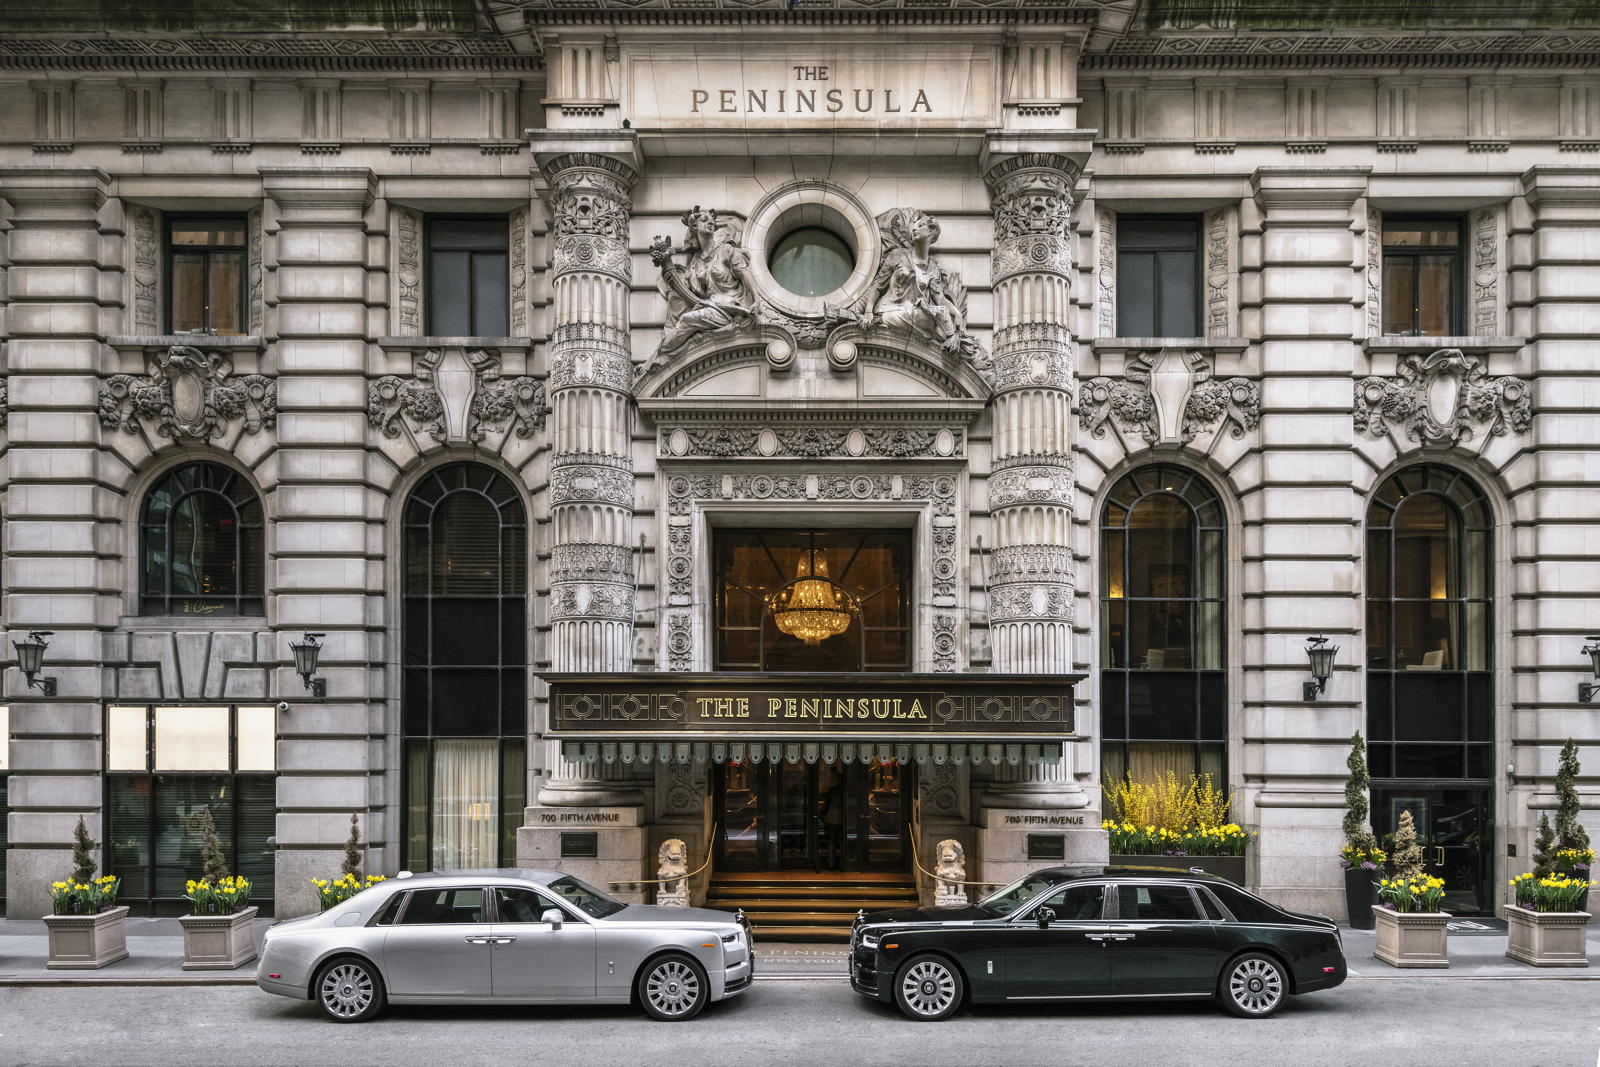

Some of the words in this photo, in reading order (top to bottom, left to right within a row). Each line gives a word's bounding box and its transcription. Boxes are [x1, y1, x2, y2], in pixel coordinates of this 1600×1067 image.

[793, 66, 829, 81] THE
[690, 88, 933, 113] PENINSULA
[696, 698, 750, 718] THE
[767, 698, 927, 719] PENINSULA
[540, 814, 557, 823] 700
[560, 814, 584, 822] FIFTH
[586, 813, 620, 822] AVENUE
[1005, 815, 1021, 824] 700
[1024, 815, 1048, 825] FIFTH
[1049, 816, 1084, 825] AVENUE
